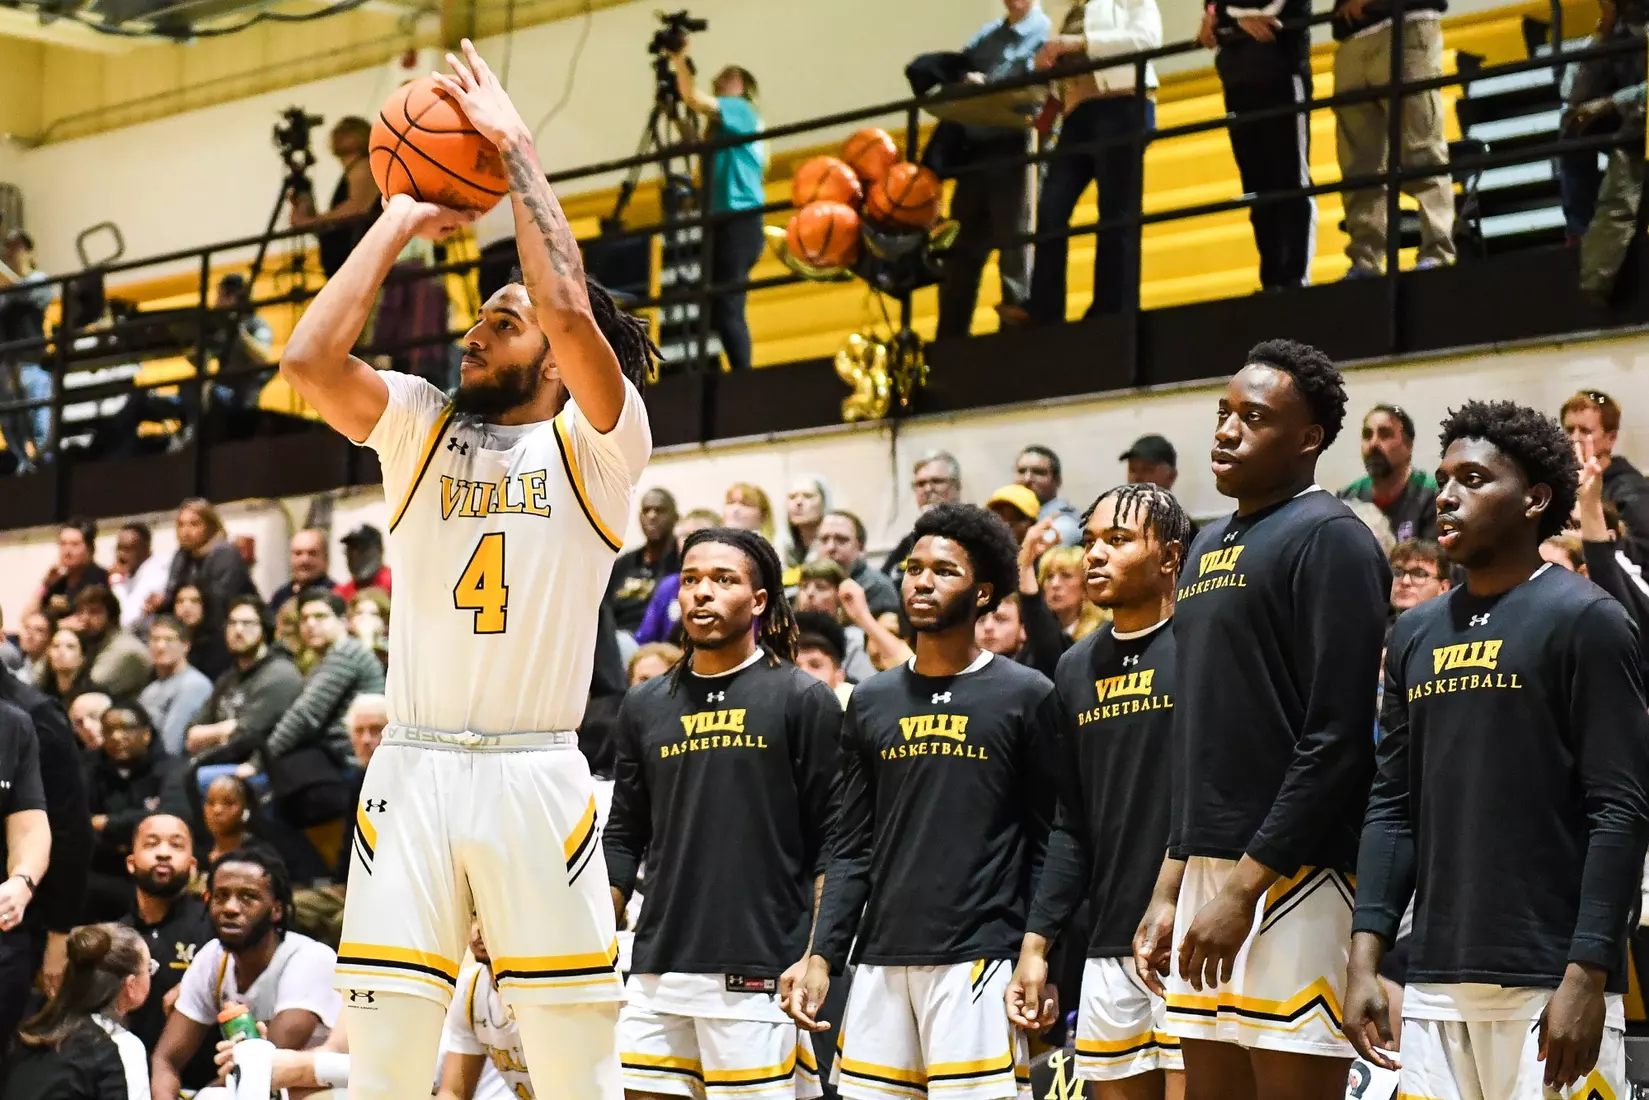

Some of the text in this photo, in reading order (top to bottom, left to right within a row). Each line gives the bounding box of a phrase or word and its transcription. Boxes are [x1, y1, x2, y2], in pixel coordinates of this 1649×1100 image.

[440, 469, 551, 521] VILLE
[1199, 545, 1245, 578] VILLE
[453, 532, 509, 634] 4
[1177, 574, 1247, 602] BASKETBALL
[1433, 640, 1503, 675] VILLE
[1095, 669, 1155, 703] VILLE
[1408, 674, 1522, 702] BASKETBALL
[681, 709, 746, 737] VILLE
[1078, 695, 1174, 726] BASKETBALL
[899, 714, 968, 742] VILLE
[661, 734, 767, 758] BASKETBALL
